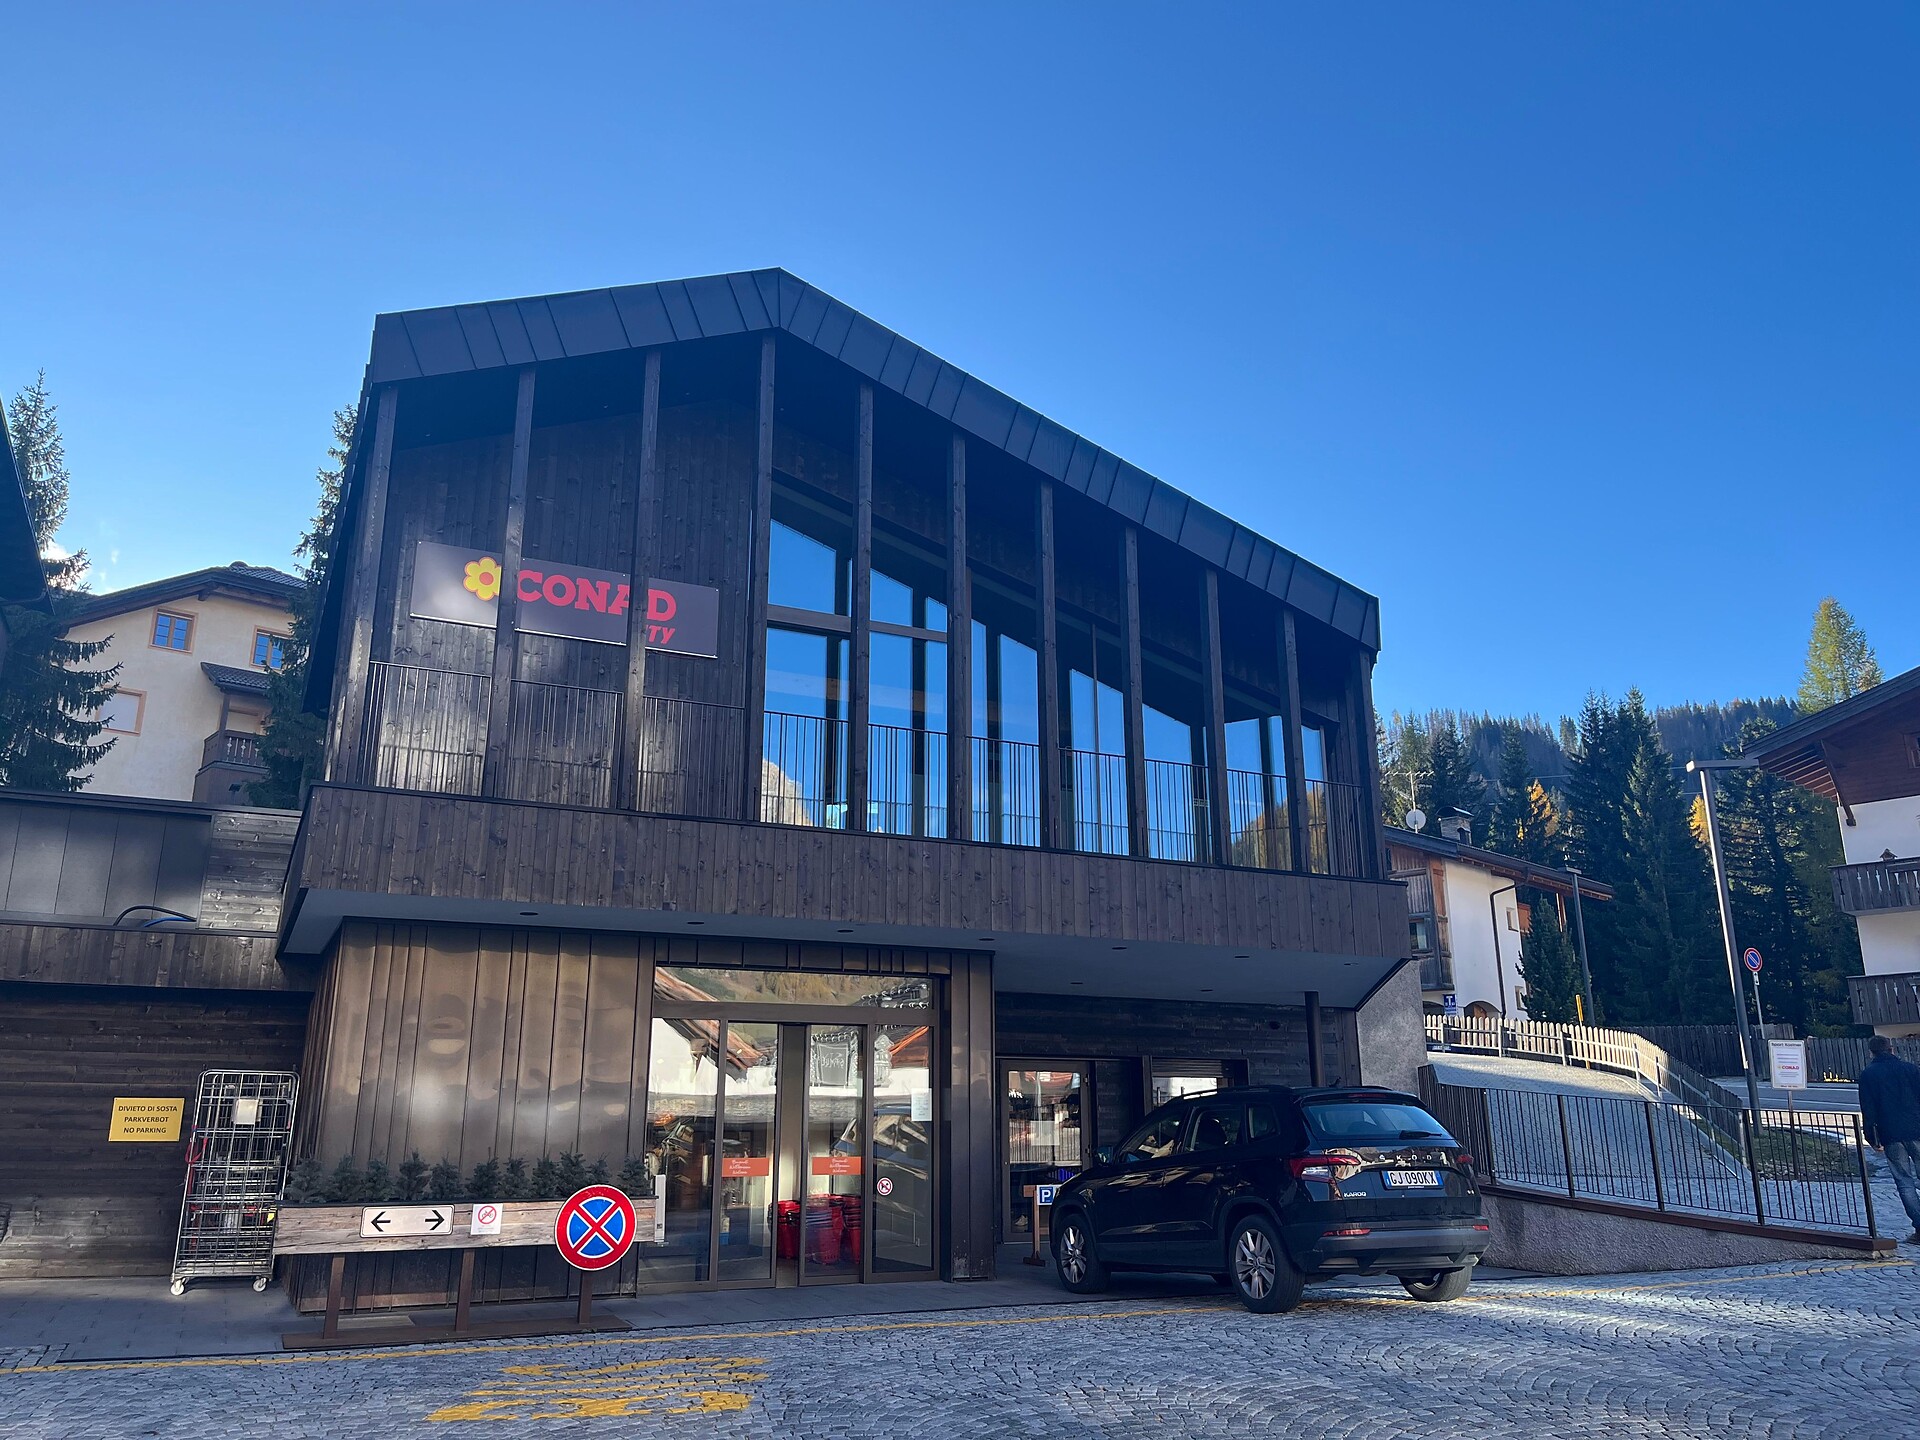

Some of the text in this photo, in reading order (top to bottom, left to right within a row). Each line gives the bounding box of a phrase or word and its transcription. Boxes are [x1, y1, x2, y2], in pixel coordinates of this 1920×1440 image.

[517, 569, 677, 622] CONAD
[645, 624, 676, 645] TY
[1041, 1189, 1051, 1203] P
